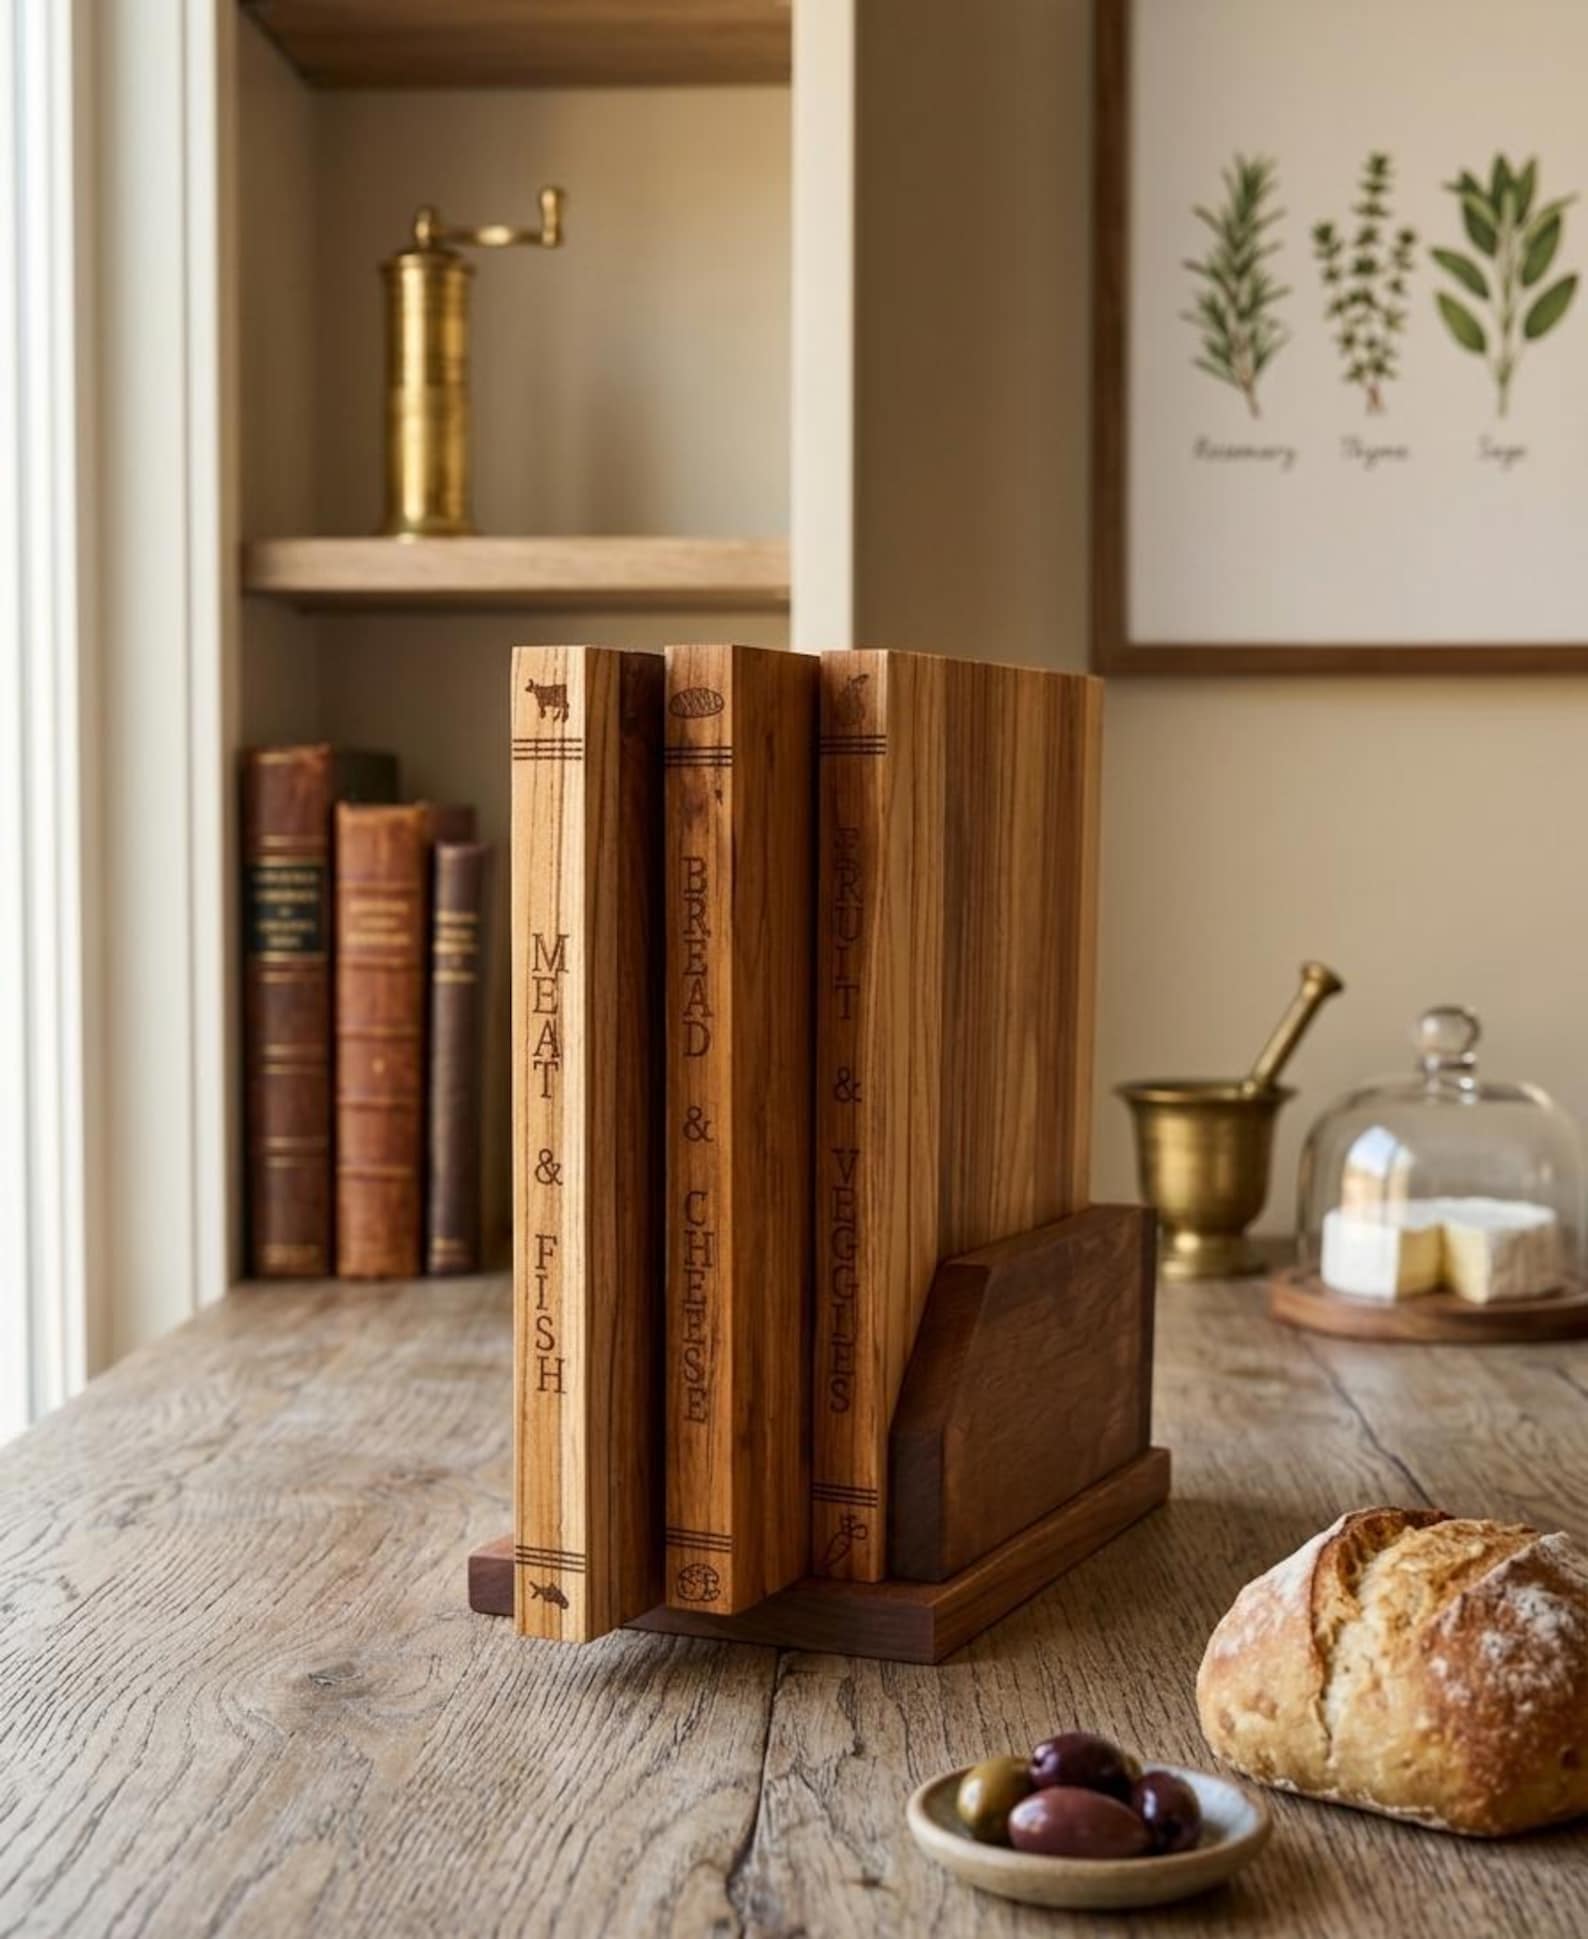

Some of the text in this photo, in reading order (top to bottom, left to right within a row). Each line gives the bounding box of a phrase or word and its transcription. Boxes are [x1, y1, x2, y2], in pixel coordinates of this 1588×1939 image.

[531, 932, 570, 1394] MEAT & FISH
[681, 856, 715, 1425] BREAD & CHEESE
[833, 1065, 862, 1104] &
[830, 1148, 860, 1414] VEGGIES
